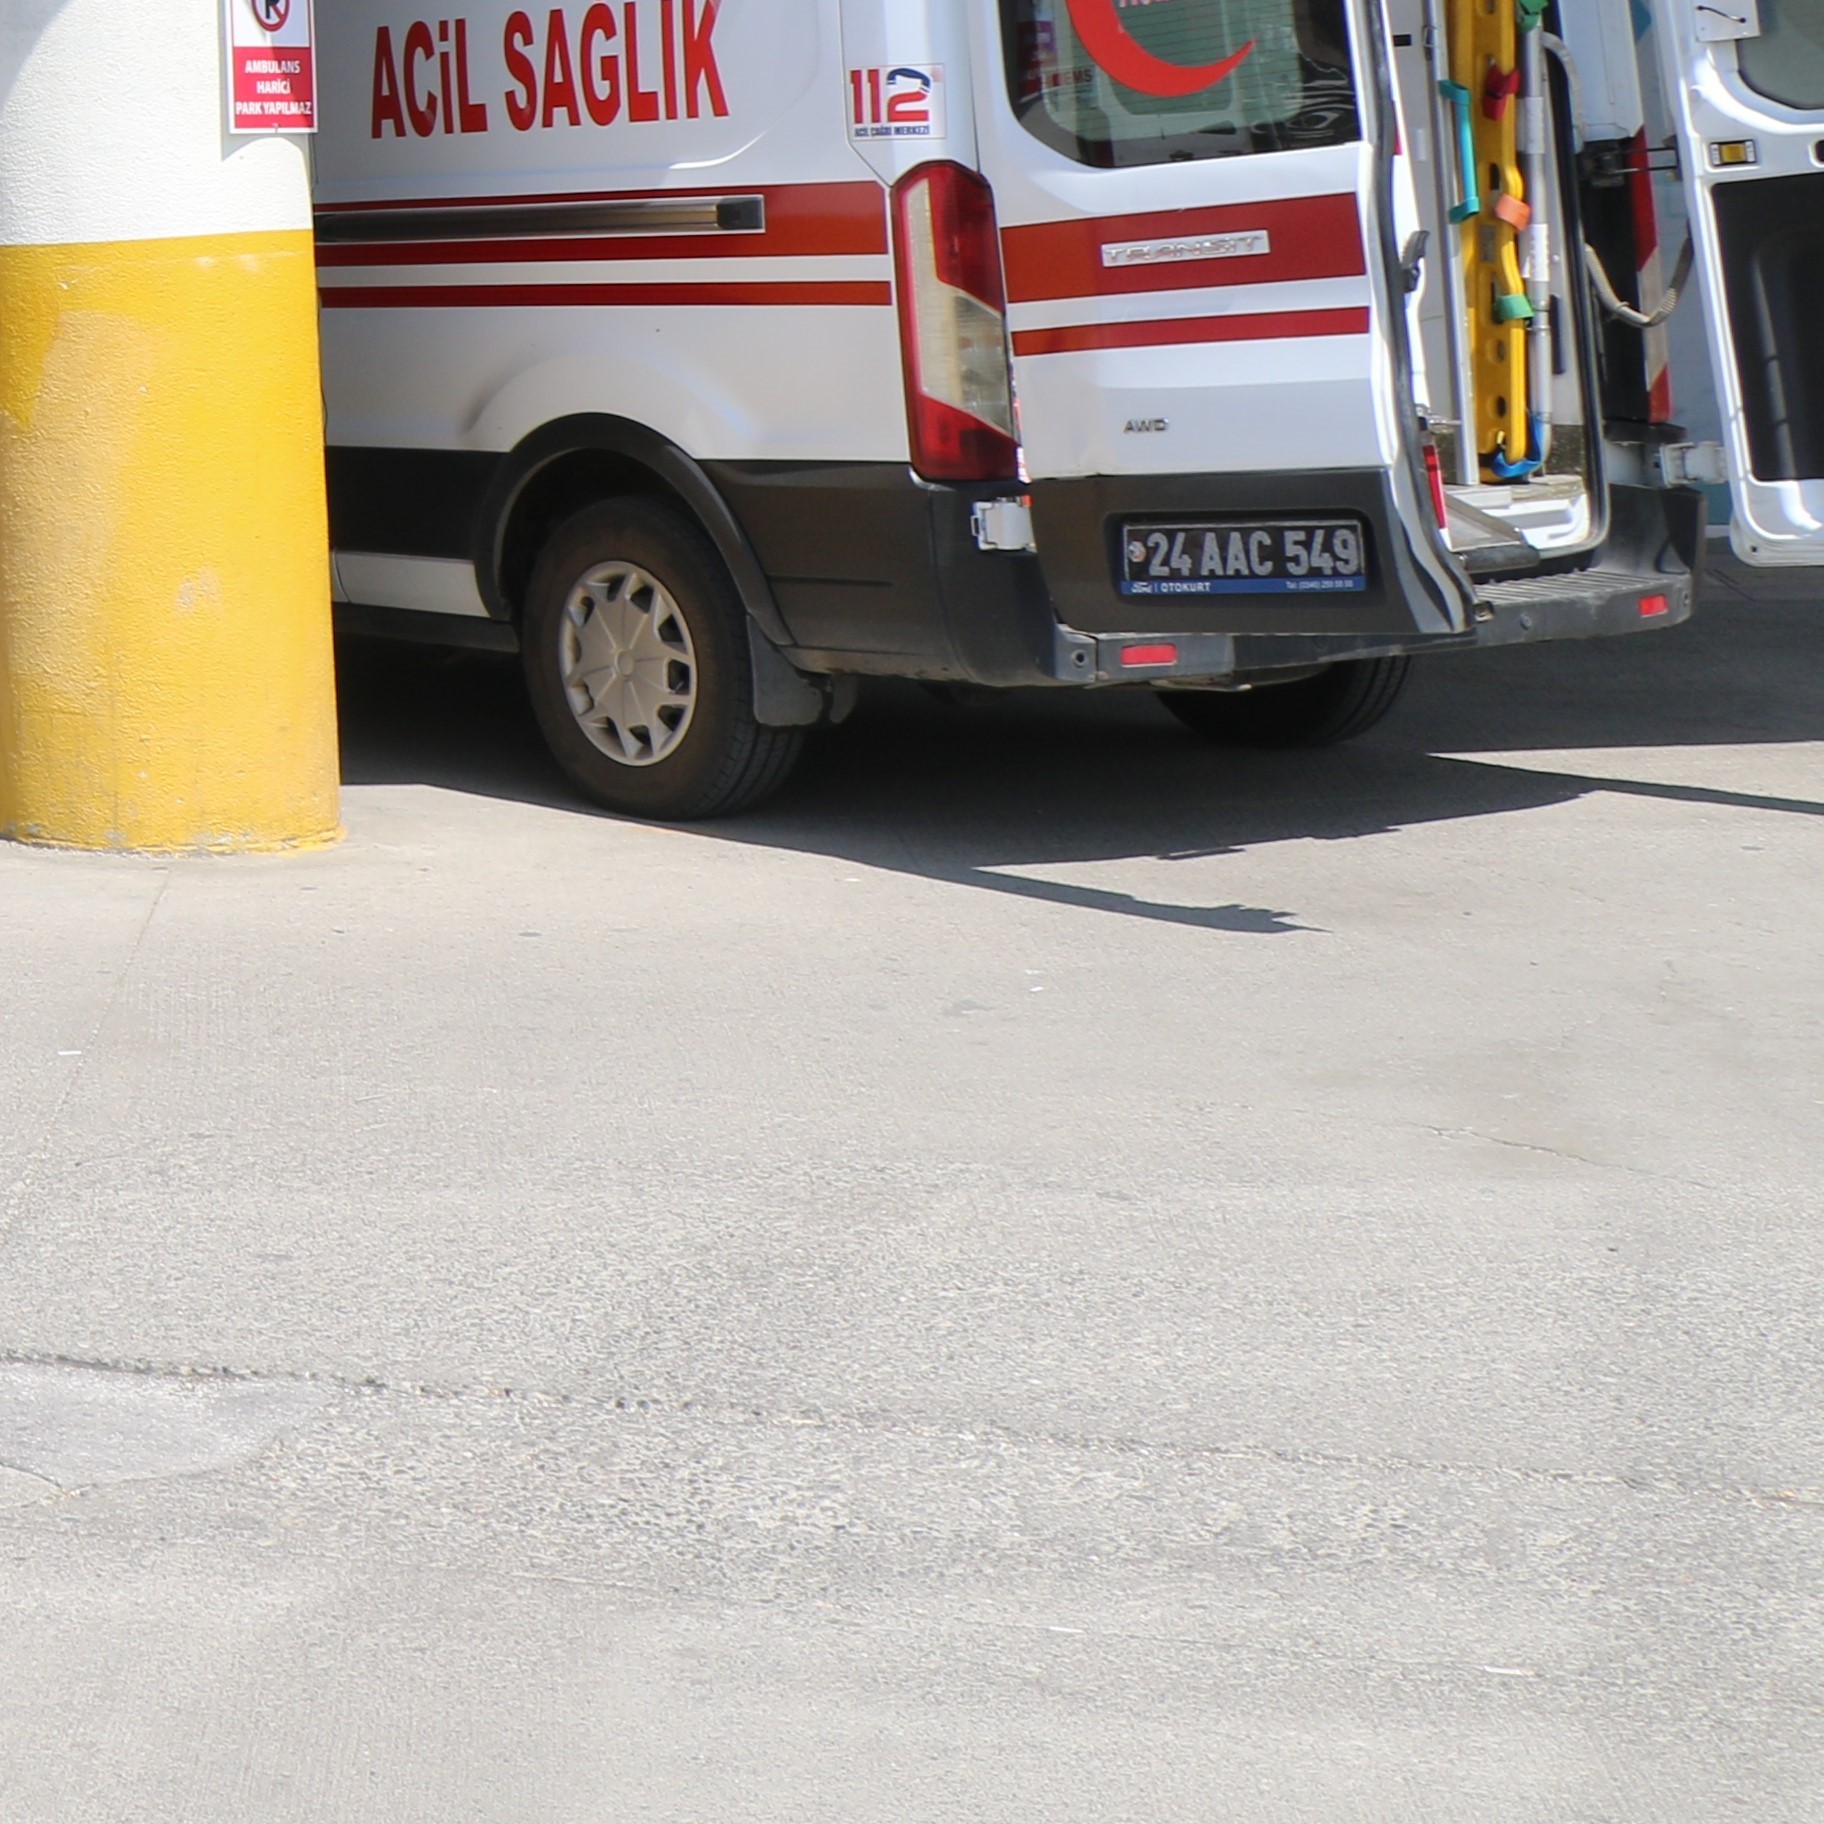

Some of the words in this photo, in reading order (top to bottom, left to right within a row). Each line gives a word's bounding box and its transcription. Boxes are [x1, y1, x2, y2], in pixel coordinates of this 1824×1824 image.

[245, 60, 300, 74] AMBULANS
[256, 78, 291, 94] HARİCİ
[850, 68, 931, 124] 112
[235, 101, 262, 115] PARK
[263, 101, 312, 115] YAPILMAZ
[1105, 236, 1264, 261] TRANSIT
[1147, 532, 1192, 576] 24
[1201, 530, 1273, 576] AAC
[1284, 529, 1359, 576] 549
[1161, 582, 1211, 592] OTOKURT
